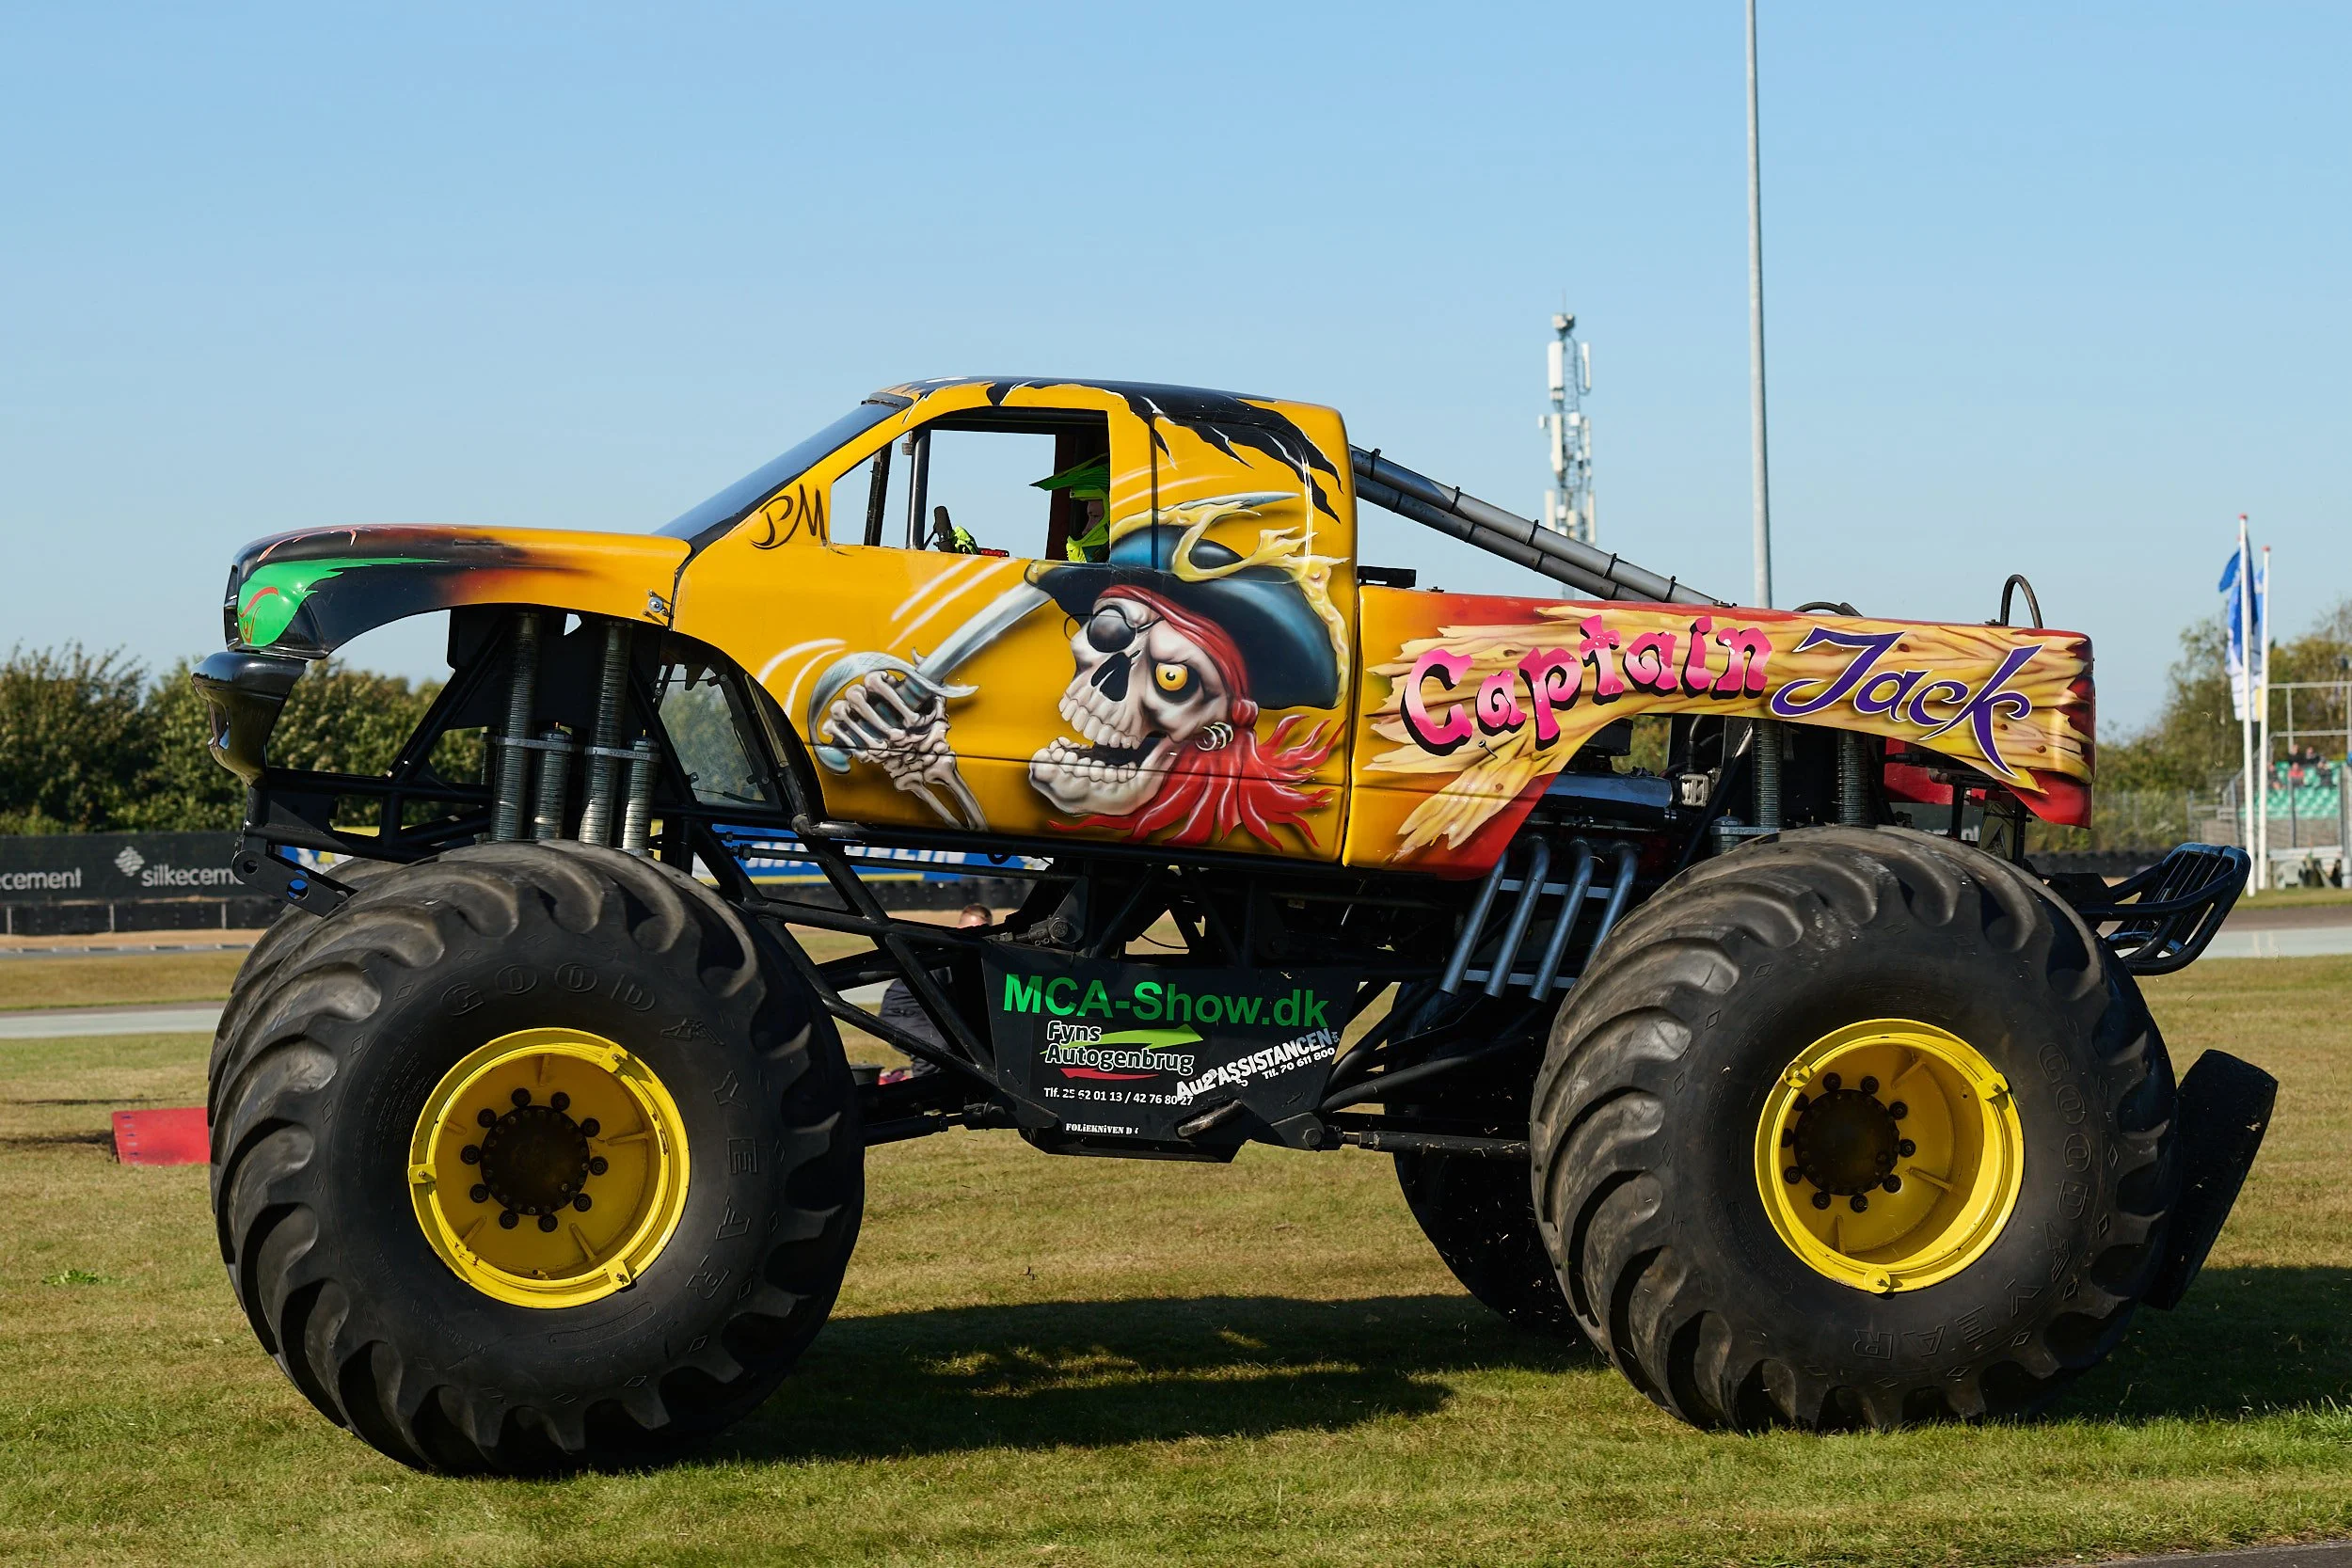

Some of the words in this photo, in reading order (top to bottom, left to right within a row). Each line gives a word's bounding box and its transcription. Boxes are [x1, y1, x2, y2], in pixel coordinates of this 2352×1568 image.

[1400, 615, 1772, 755] Captain
[1771, 627, 2045, 779] Jack
[0, 867, 82, 890] cement
[1003, 974, 1329, 1028] MCA-Show.dk
[1047, 1021, 1102, 1045] Fyns
[1045, 1043, 1194, 1076] Autogenbrug
[1295, 1055, 1312, 1068] 611
[1313, 1047, 1336, 1061] 800
[1043, 1087, 1060, 1098] Tlf.
[1062, 1088, 1075, 1099] 25
[1093, 1090, 1106, 1101] 01
[1109, 1091, 1122, 1102] 13
[1133, 1093, 1147, 1103] 42
[1149, 1093, 1163, 1104] 76
[1164, 1094, 1177, 1105] 80
[1180, 1096, 1194, 1106] 27
